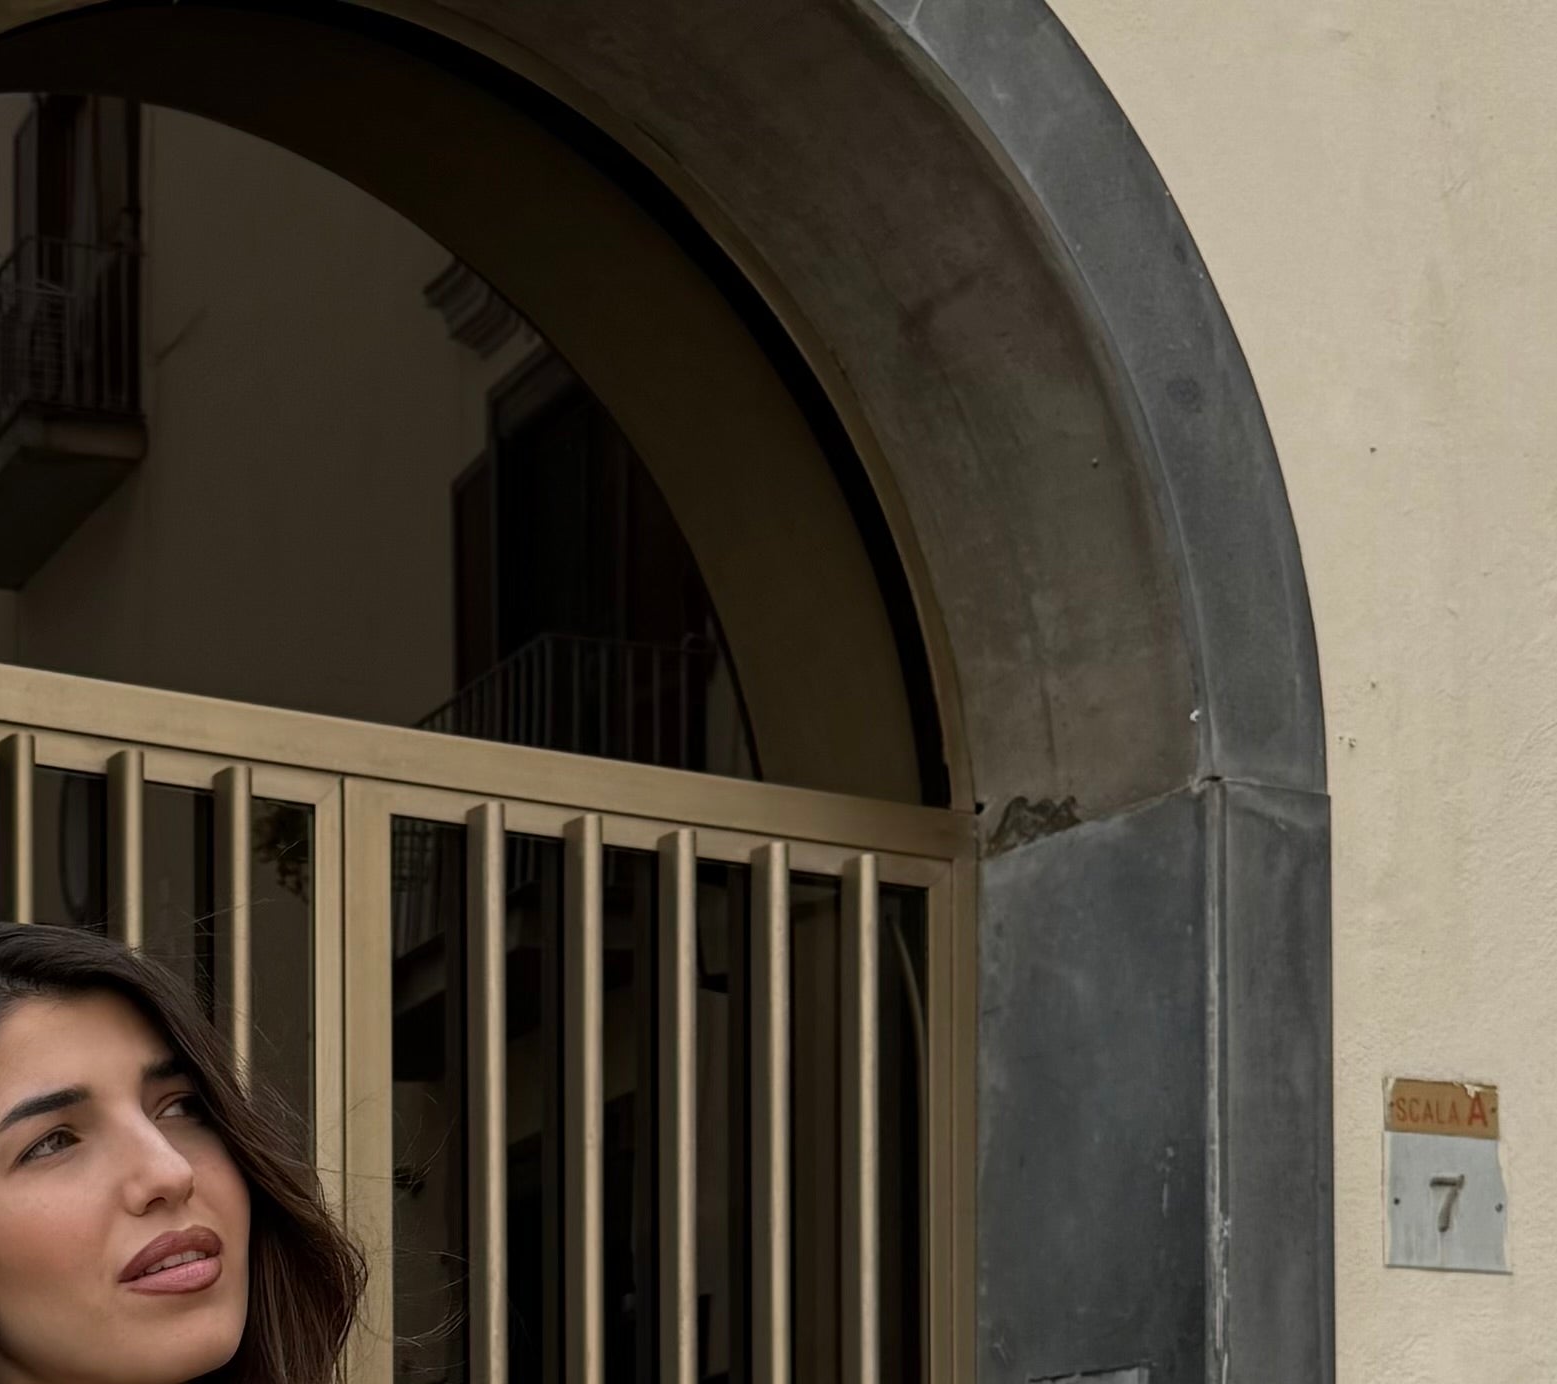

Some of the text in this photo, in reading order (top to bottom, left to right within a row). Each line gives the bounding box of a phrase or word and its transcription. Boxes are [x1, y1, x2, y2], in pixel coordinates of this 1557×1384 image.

[1397, 1094, 1489, 1128] SCALA A
[1430, 1174, 1465, 1233] 7
